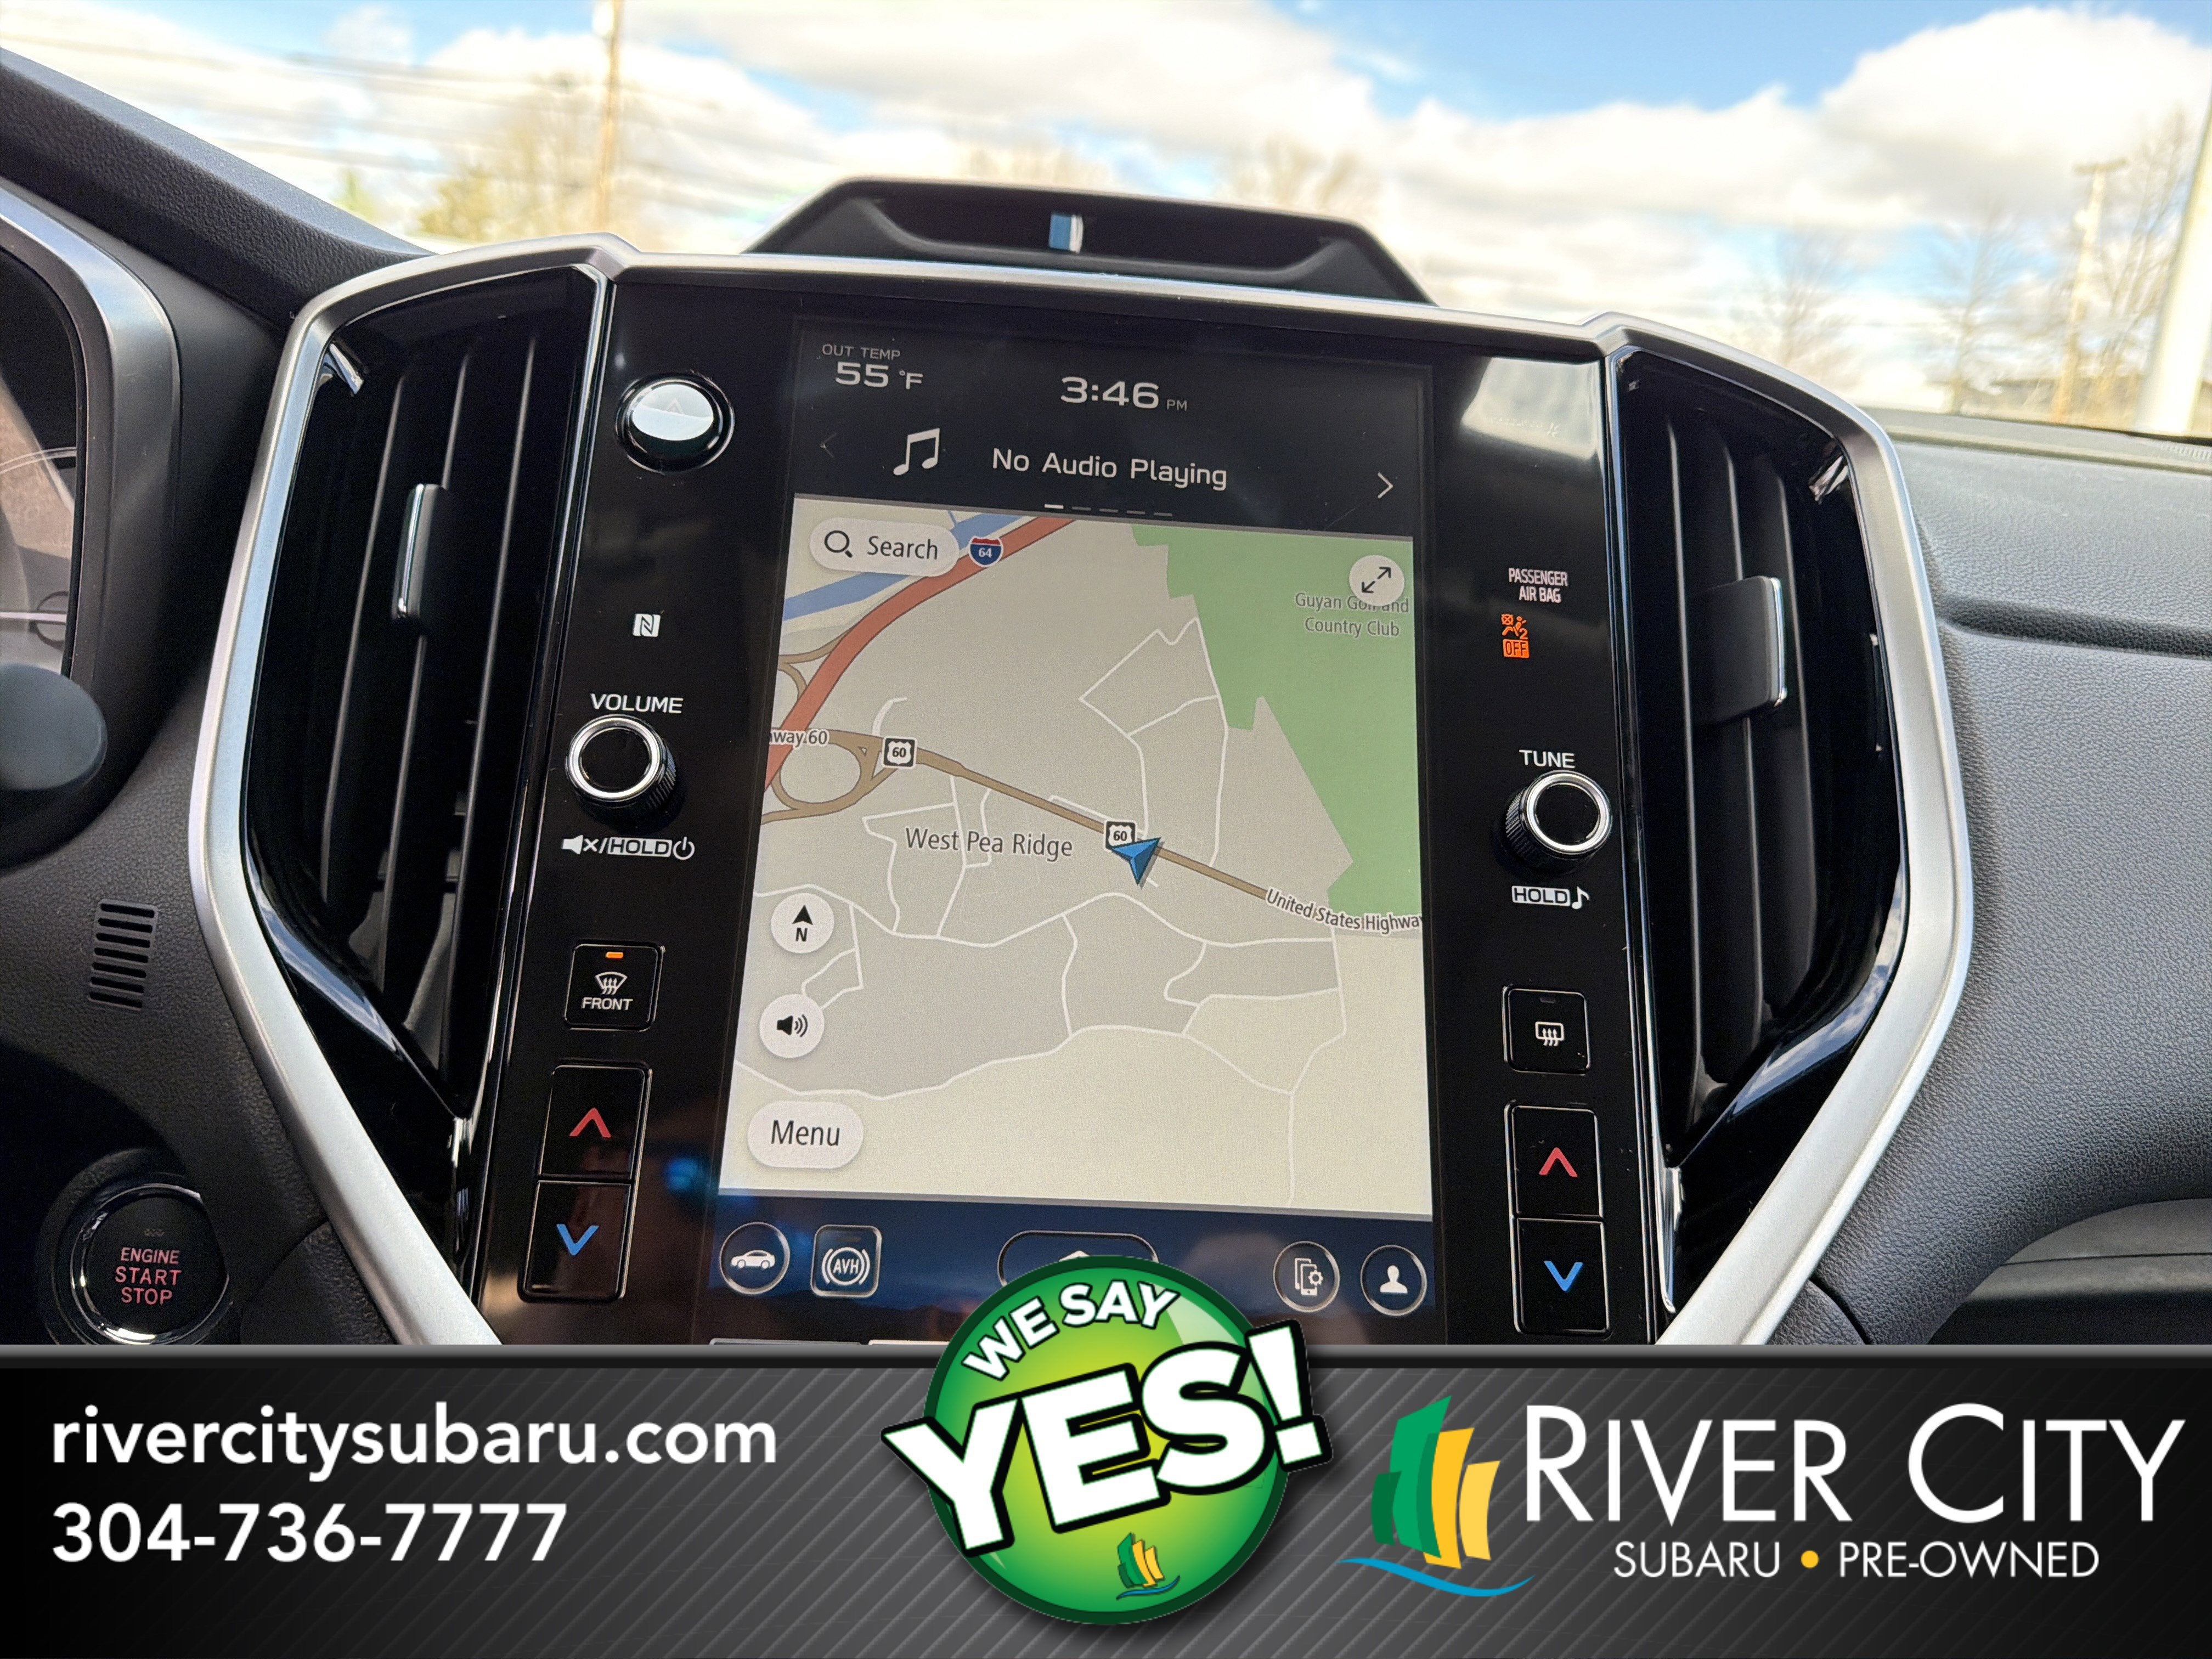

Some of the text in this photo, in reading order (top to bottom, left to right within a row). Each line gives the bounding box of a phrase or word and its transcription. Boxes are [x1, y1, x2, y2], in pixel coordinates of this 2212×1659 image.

[822, 343, 901, 360] OUT TEMP
[836, 362, 889, 387] 55
[1060, 376, 1187, 411] 3:46 PM
[992, 448, 1227, 491] No Audio Playing
[867, 535, 938, 560] Search
[978, 547, 992, 558] 64
[1508, 567, 1568, 587] PASSENGER
[1295, 592, 1341, 612] Guyan
[1519, 585, 1562, 603] AIR BAG
[1305, 617, 1400, 638] Country Club
[1505, 641, 1527, 656] OFF
[590, 693, 684, 714] VOLUME
[808, 730, 828, 744] 60
[892, 747, 907, 758] 60
[1519, 749, 1576, 768] TUNE
[906, 828, 1073, 862] West Pea Ridge
[1113, 830, 1127, 842] 60
[1513, 887, 1568, 905] HOLD
[1266, 888, 1314, 918] United
[1315, 907, 1361, 929] States
[795, 927, 808, 942] N
[581, 997, 633, 1011] FRONT
[771, 1119, 840, 1147] Menu
[120, 1247, 180, 1265] ENGINE
[115, 1266, 182, 1286] START
[833, 1257, 860, 1276] AVH
[121, 1286, 172, 1305] STOP
